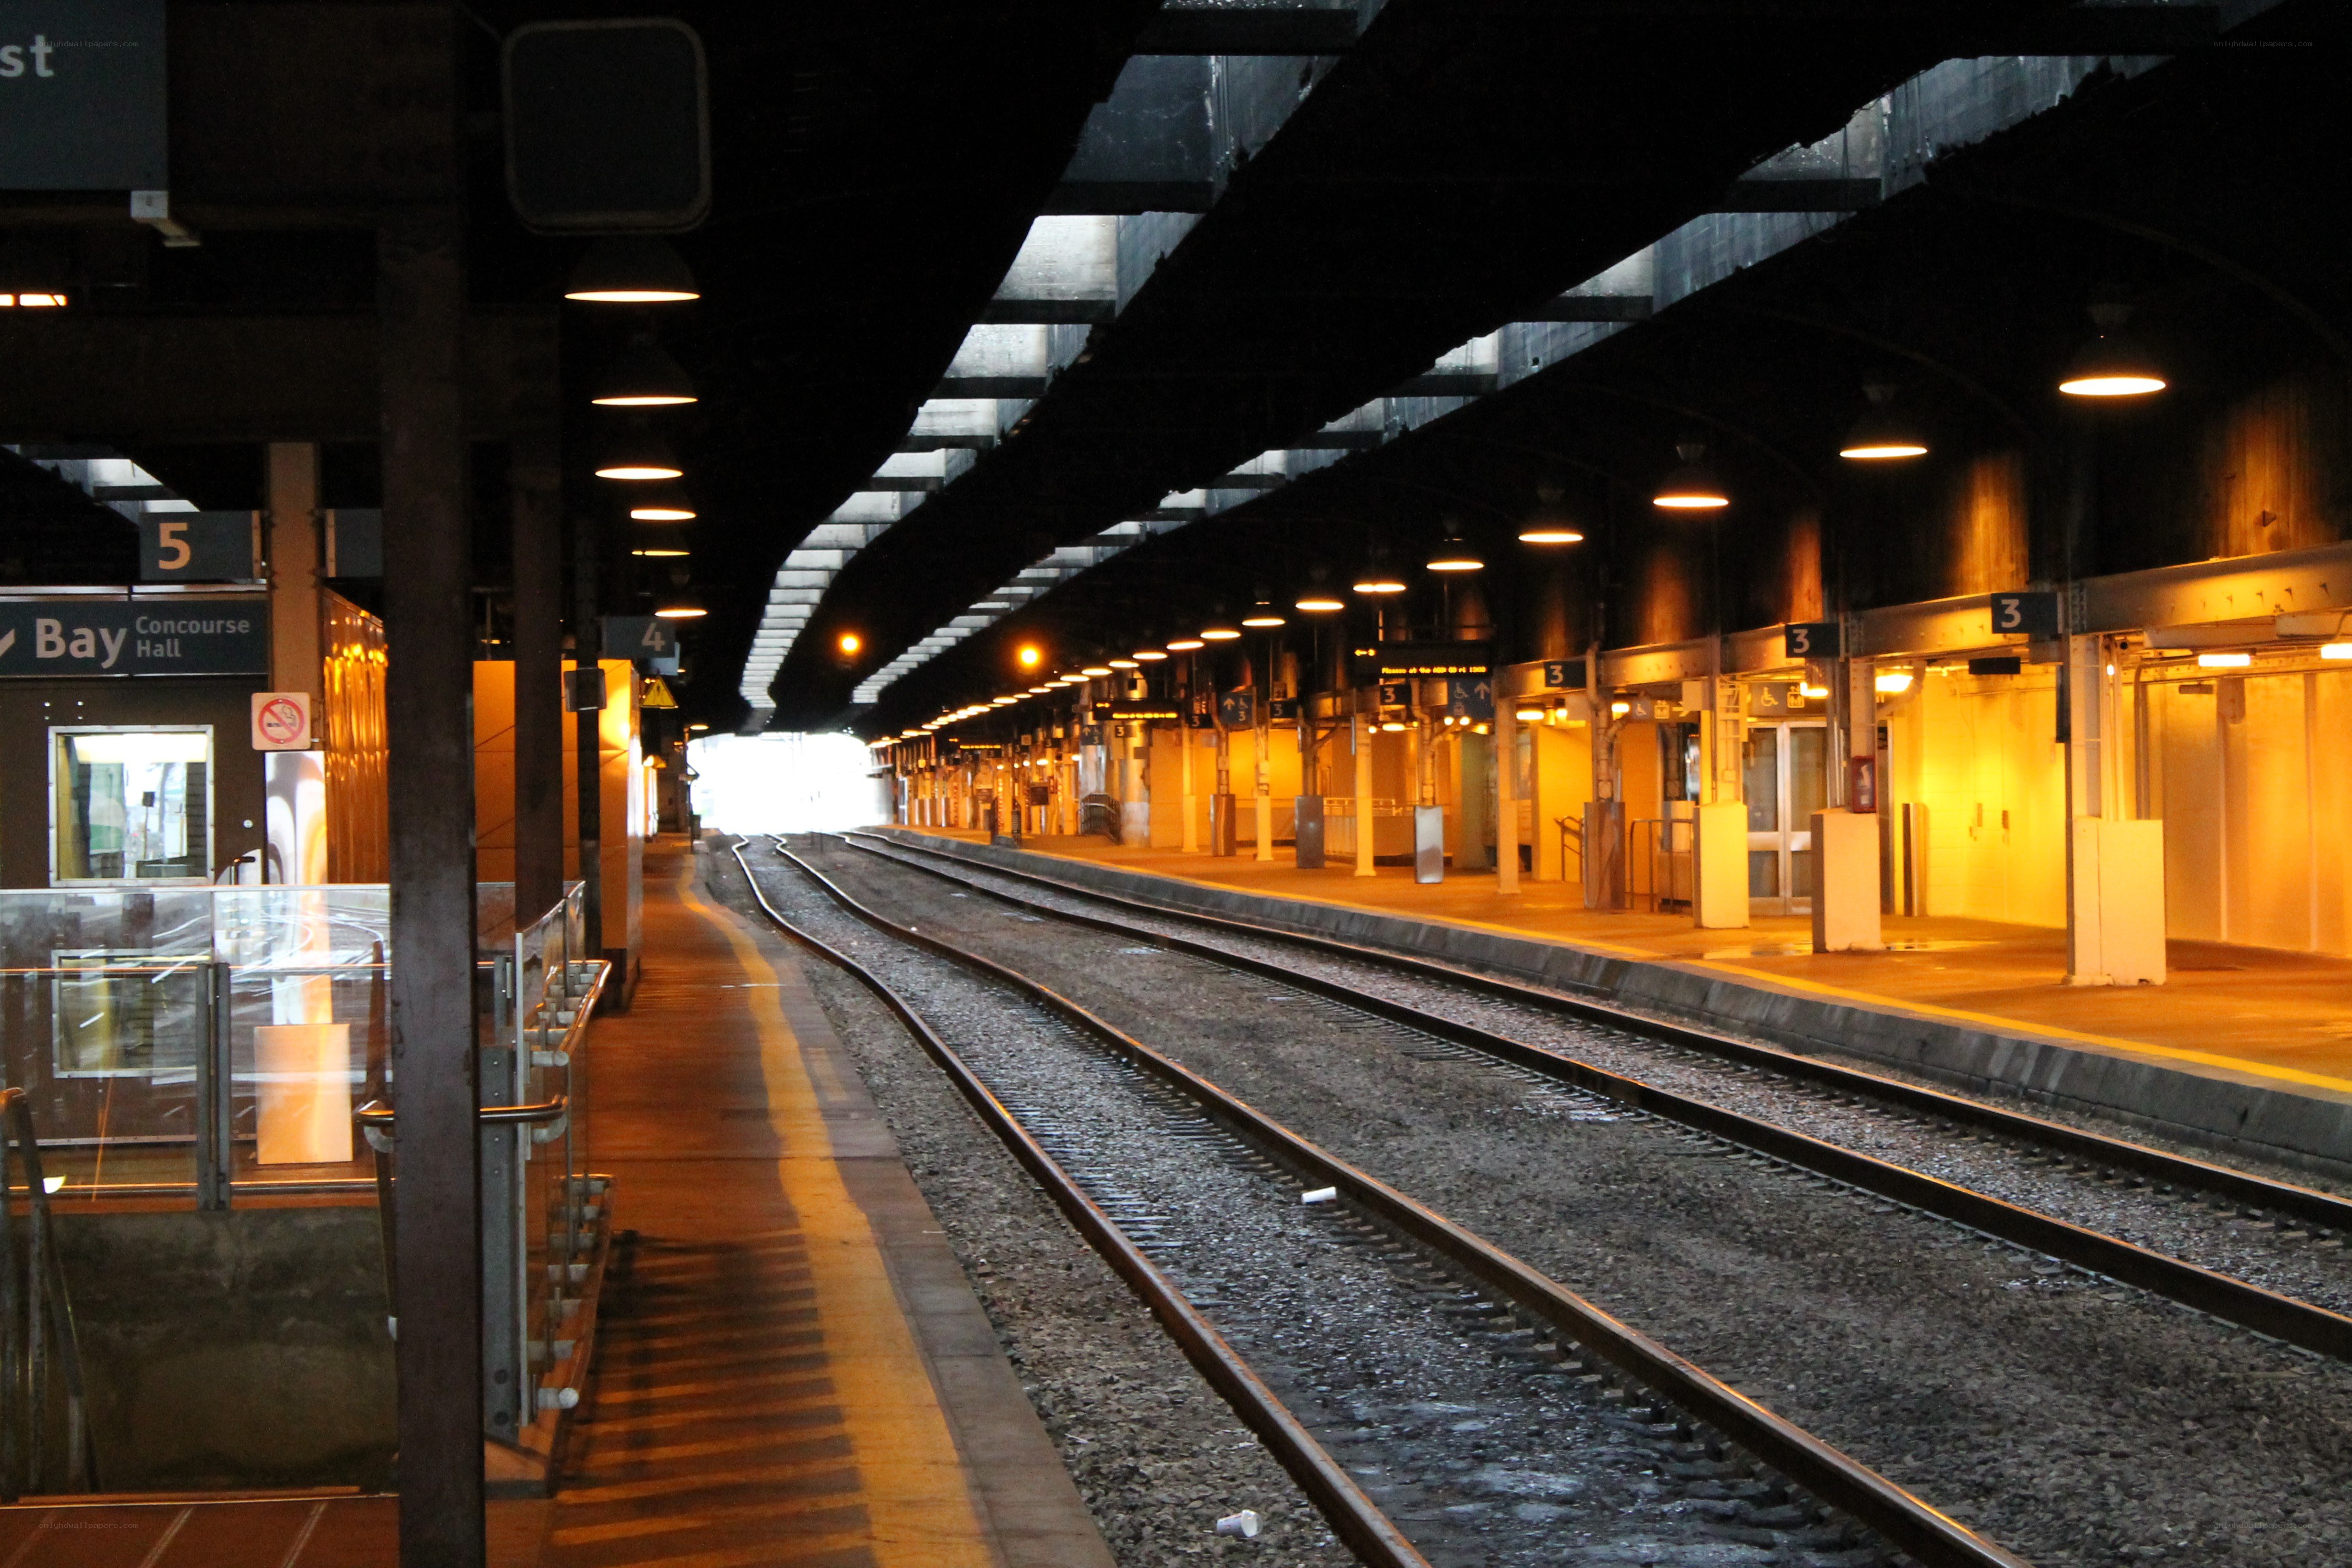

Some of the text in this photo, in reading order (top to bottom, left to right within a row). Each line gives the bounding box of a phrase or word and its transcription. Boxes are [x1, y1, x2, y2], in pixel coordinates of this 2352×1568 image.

[157, 521, 192, 570] 5
[2000, 599, 2021, 628] 3
[135, 616, 251, 634] Concourse
[35, 617, 127, 669] Bay
[641, 623, 666, 652] 4
[1793, 629, 1810, 654] 3
[136, 638, 181, 658] Hall
[1550, 664, 1564, 684] 3
[1384, 687, 1396, 703] 3
[1238, 711, 1246, 722] 3
[1273, 704, 1283, 716] 3
[1192, 715, 1200, 727] 3
[1093, 736, 1099, 744] 3
[1117, 726, 1124, 737] 3
